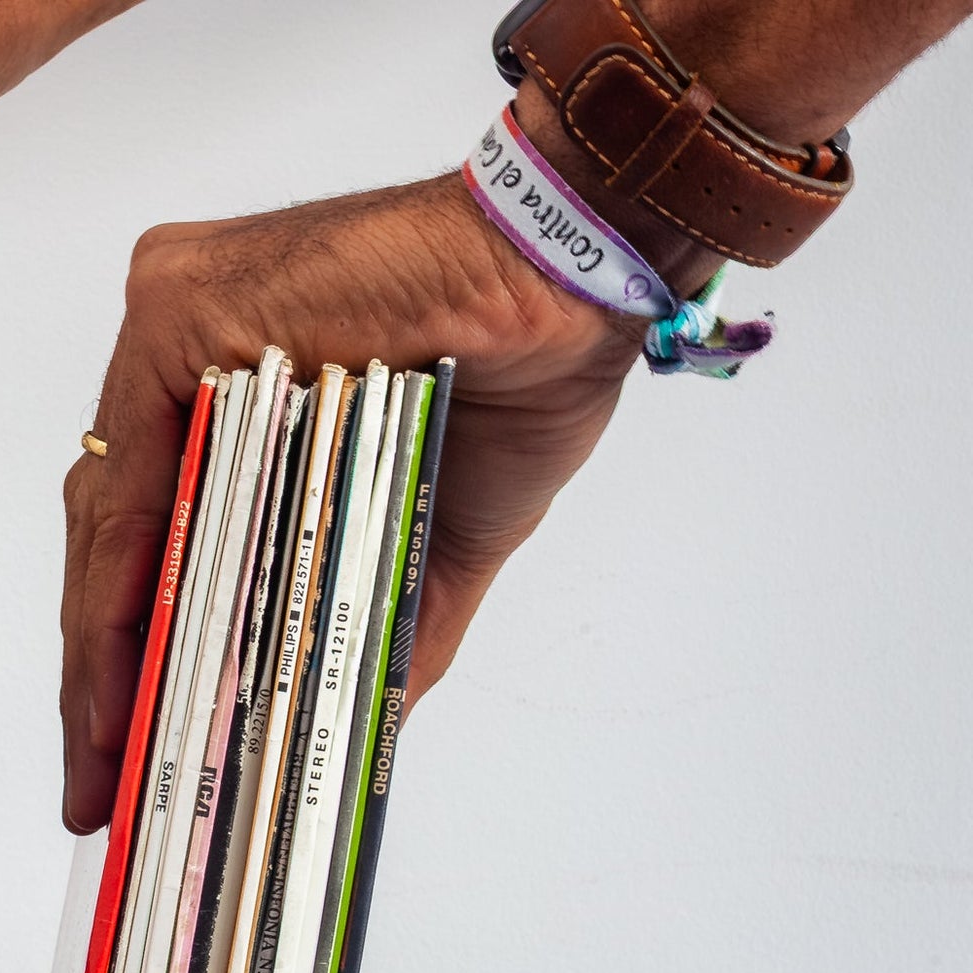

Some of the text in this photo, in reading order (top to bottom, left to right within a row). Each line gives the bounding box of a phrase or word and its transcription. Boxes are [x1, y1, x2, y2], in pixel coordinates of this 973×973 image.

[490, 160, 522, 187] el
[520, 185, 605, 272] Contra
[163, 501, 191, 605] LP-33194/T-B22
[406, 522, 424, 595] 45097
[280, 542, 312, 676] PHILIPS 822 571-1
[326, 601, 350, 690] SR-12100
[248, 688, 271, 755] 89.2215/0
[373, 687, 406, 795] ROACHFORD
[155, 761, 174, 814] SARPE
[306, 727, 329, 806] STEREO
